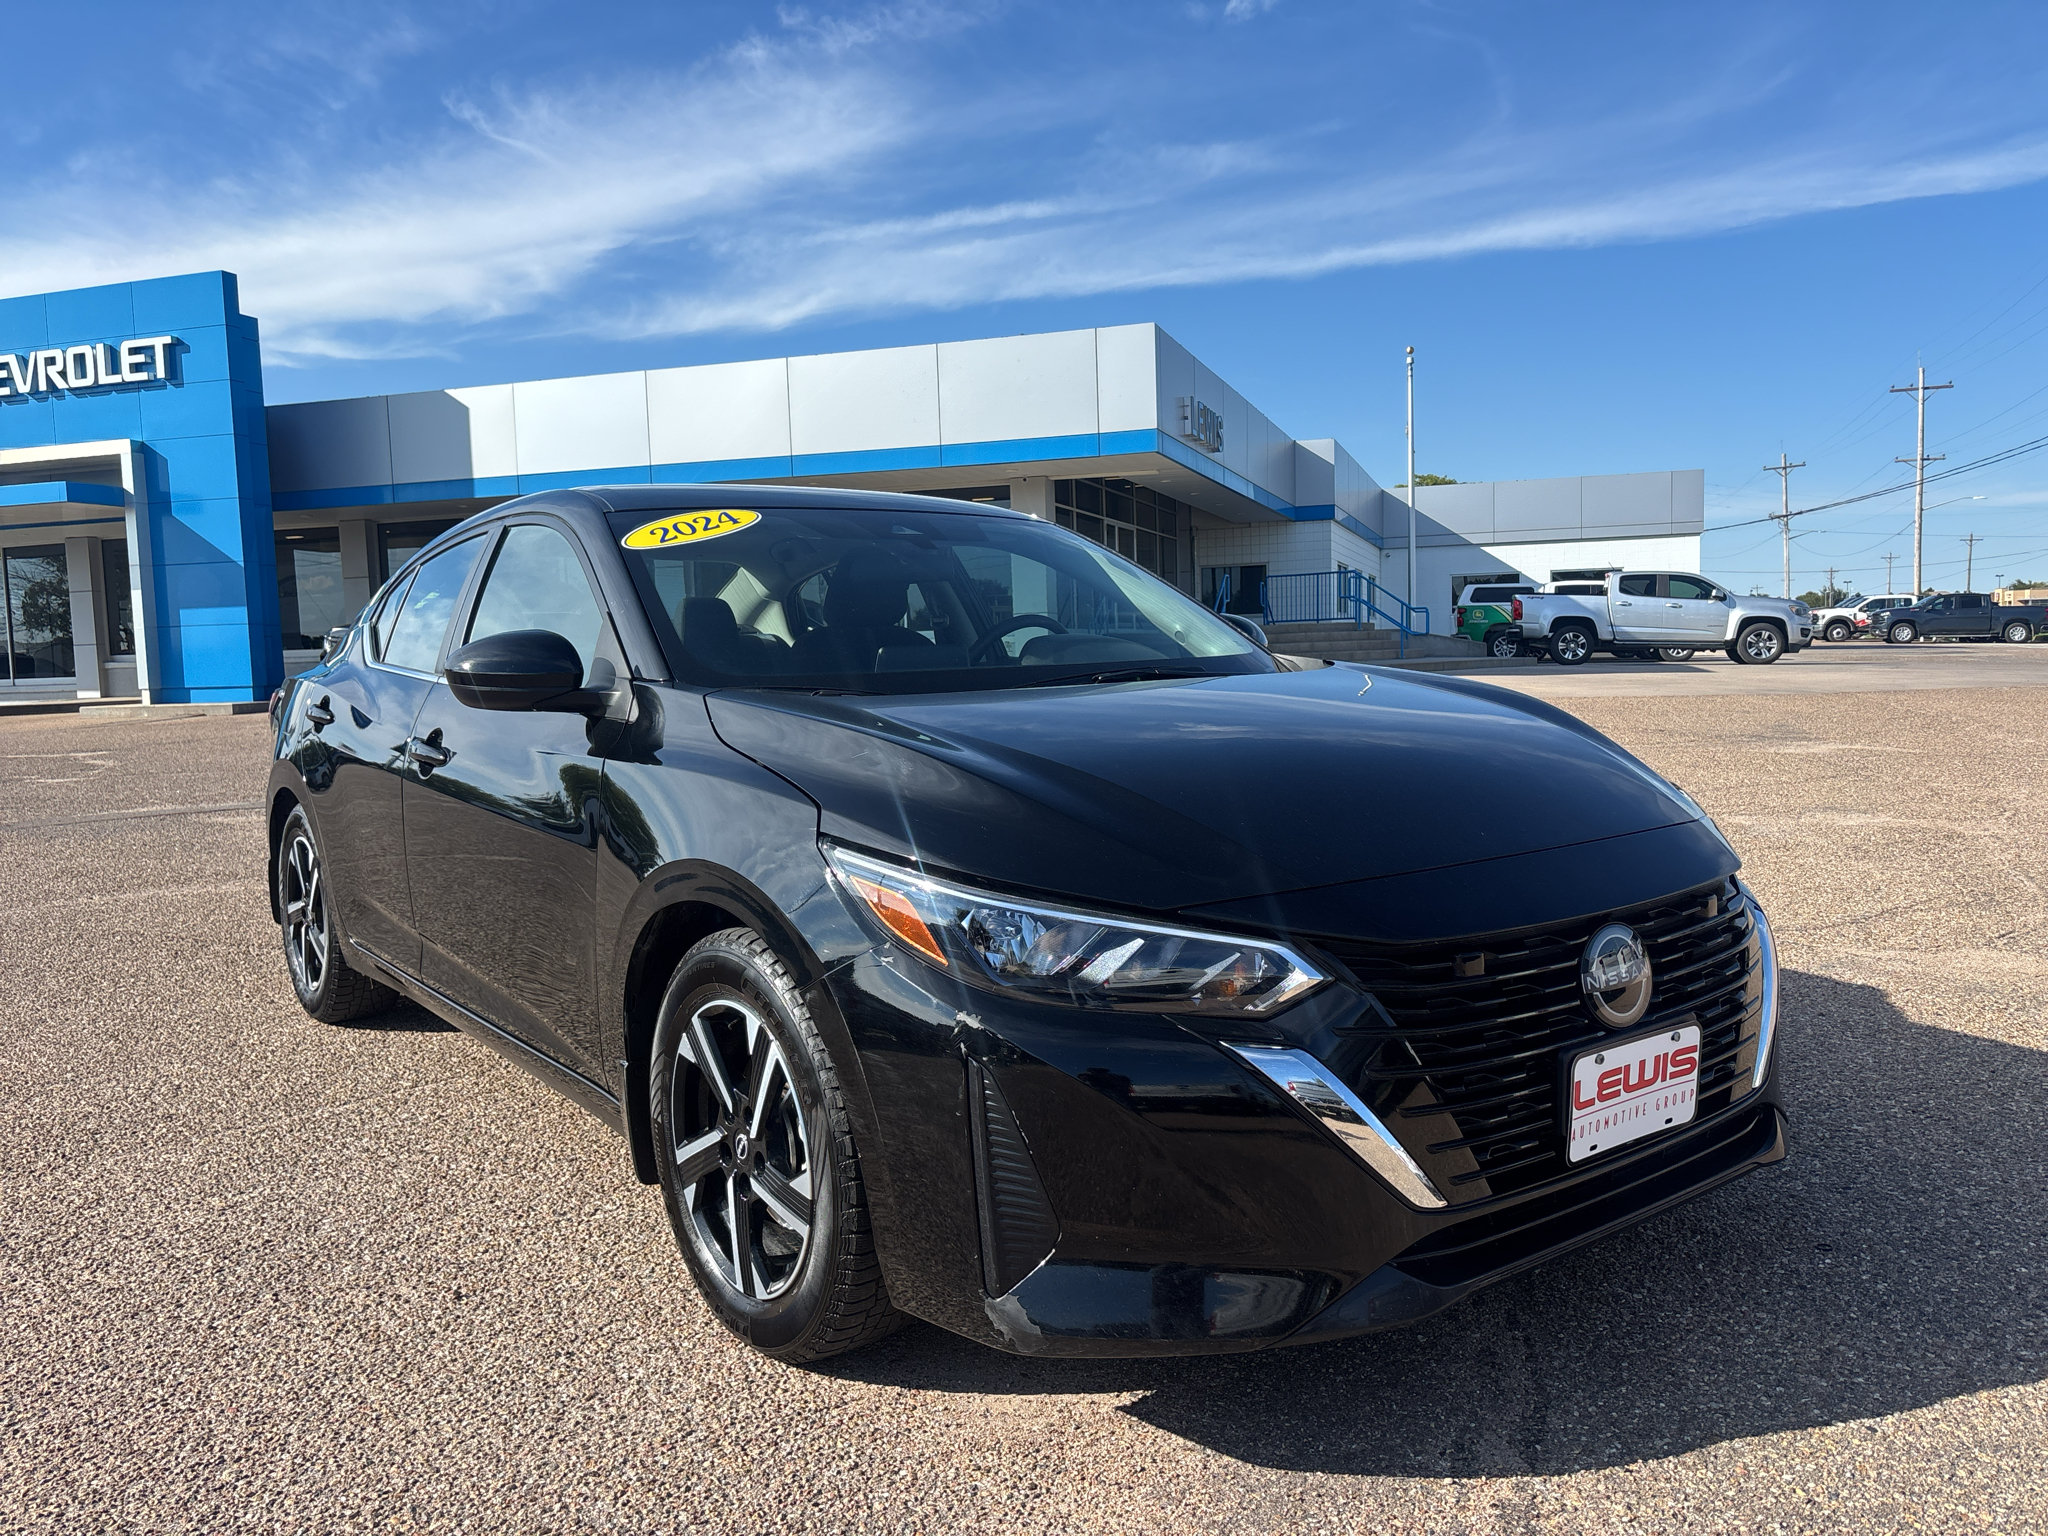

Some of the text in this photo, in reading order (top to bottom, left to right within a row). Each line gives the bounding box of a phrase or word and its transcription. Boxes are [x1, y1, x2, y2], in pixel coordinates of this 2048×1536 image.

[649, 511, 741, 543] 2024
[1586, 960, 1649, 990] NISSAN
[1574, 1045, 1698, 1111] LEWIS
[1571, 1088, 1695, 1142] AUTOMOTIVE GROUP
